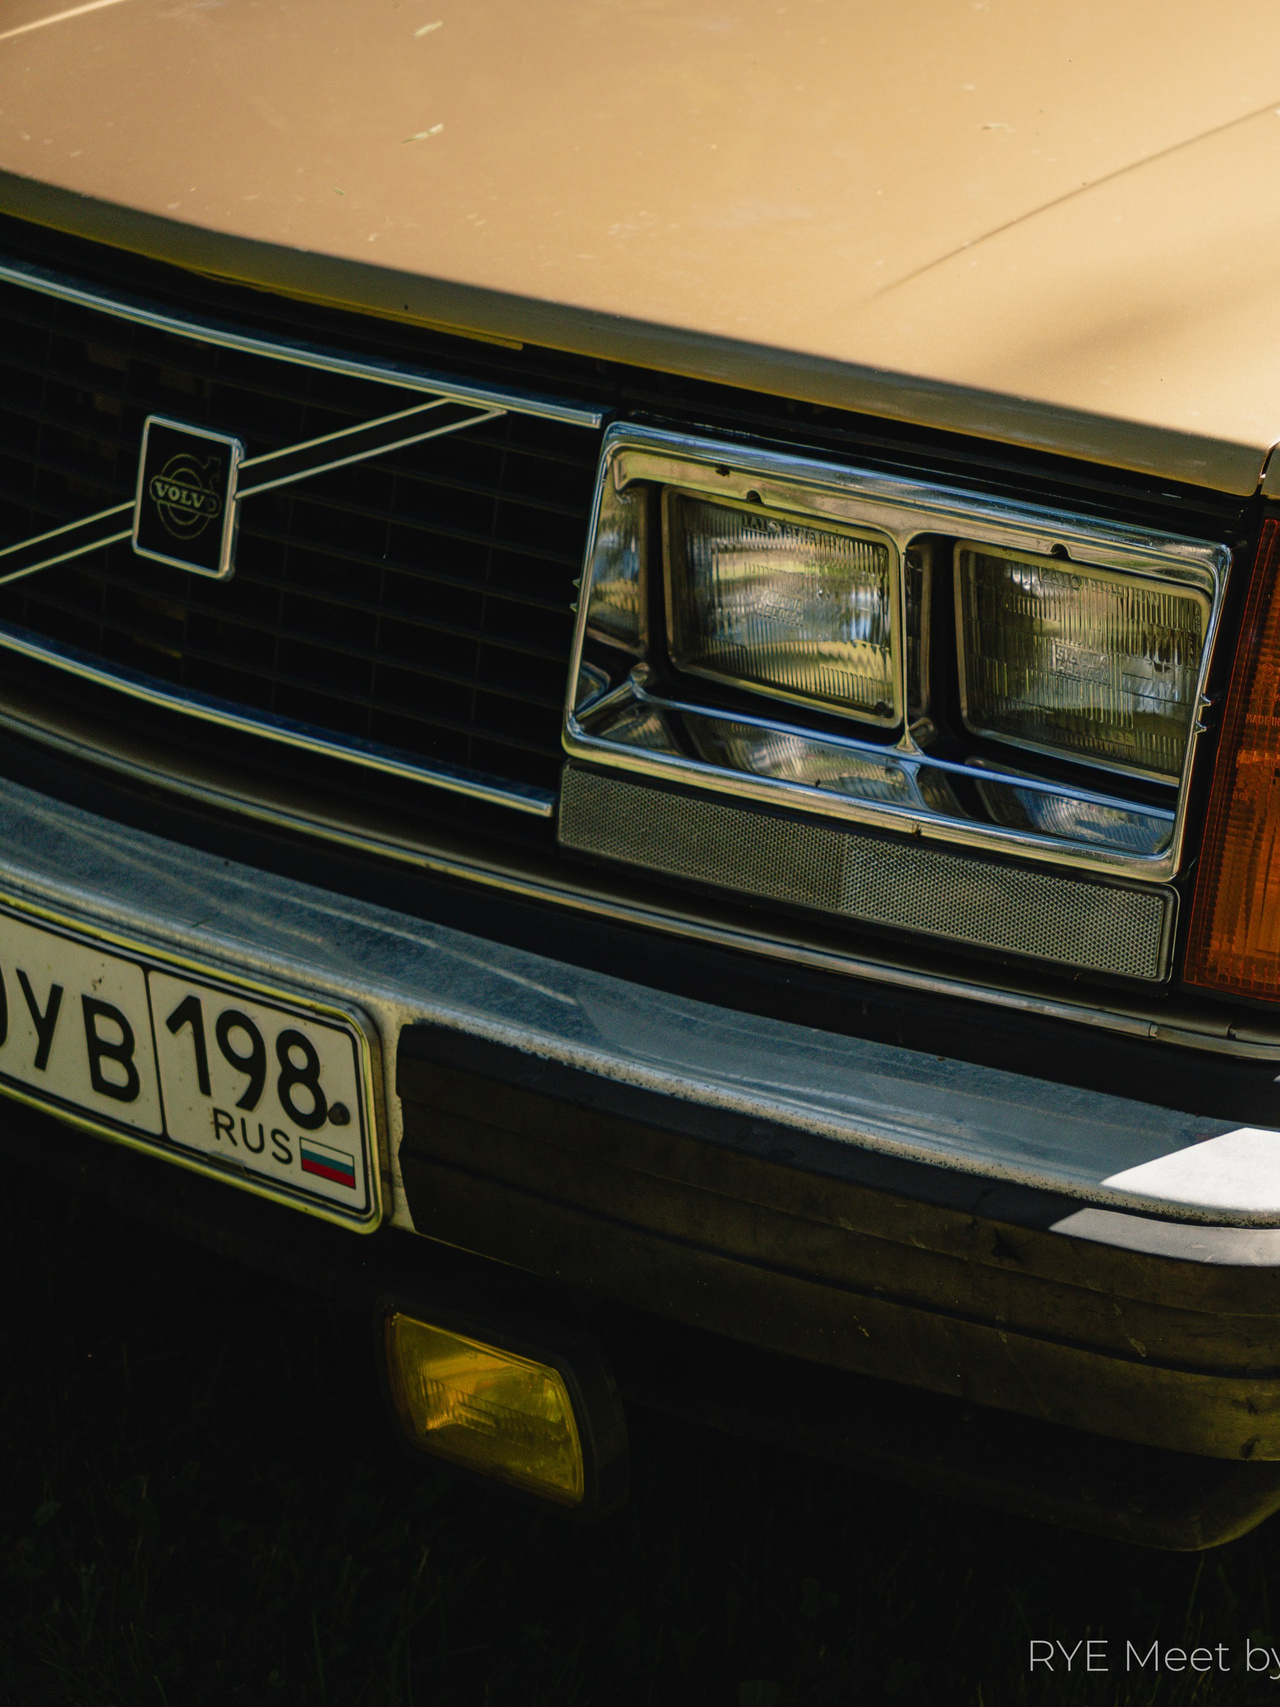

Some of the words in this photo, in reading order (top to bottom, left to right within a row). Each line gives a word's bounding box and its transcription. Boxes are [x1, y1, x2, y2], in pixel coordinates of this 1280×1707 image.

[154, 481, 217, 512] VOLVO
[1246, 713, 1271, 725] MADE
[1272, 716, 1280, 727] IN
[165, 994, 328, 1131] 198
[212, 1106, 293, 1165] RUS
